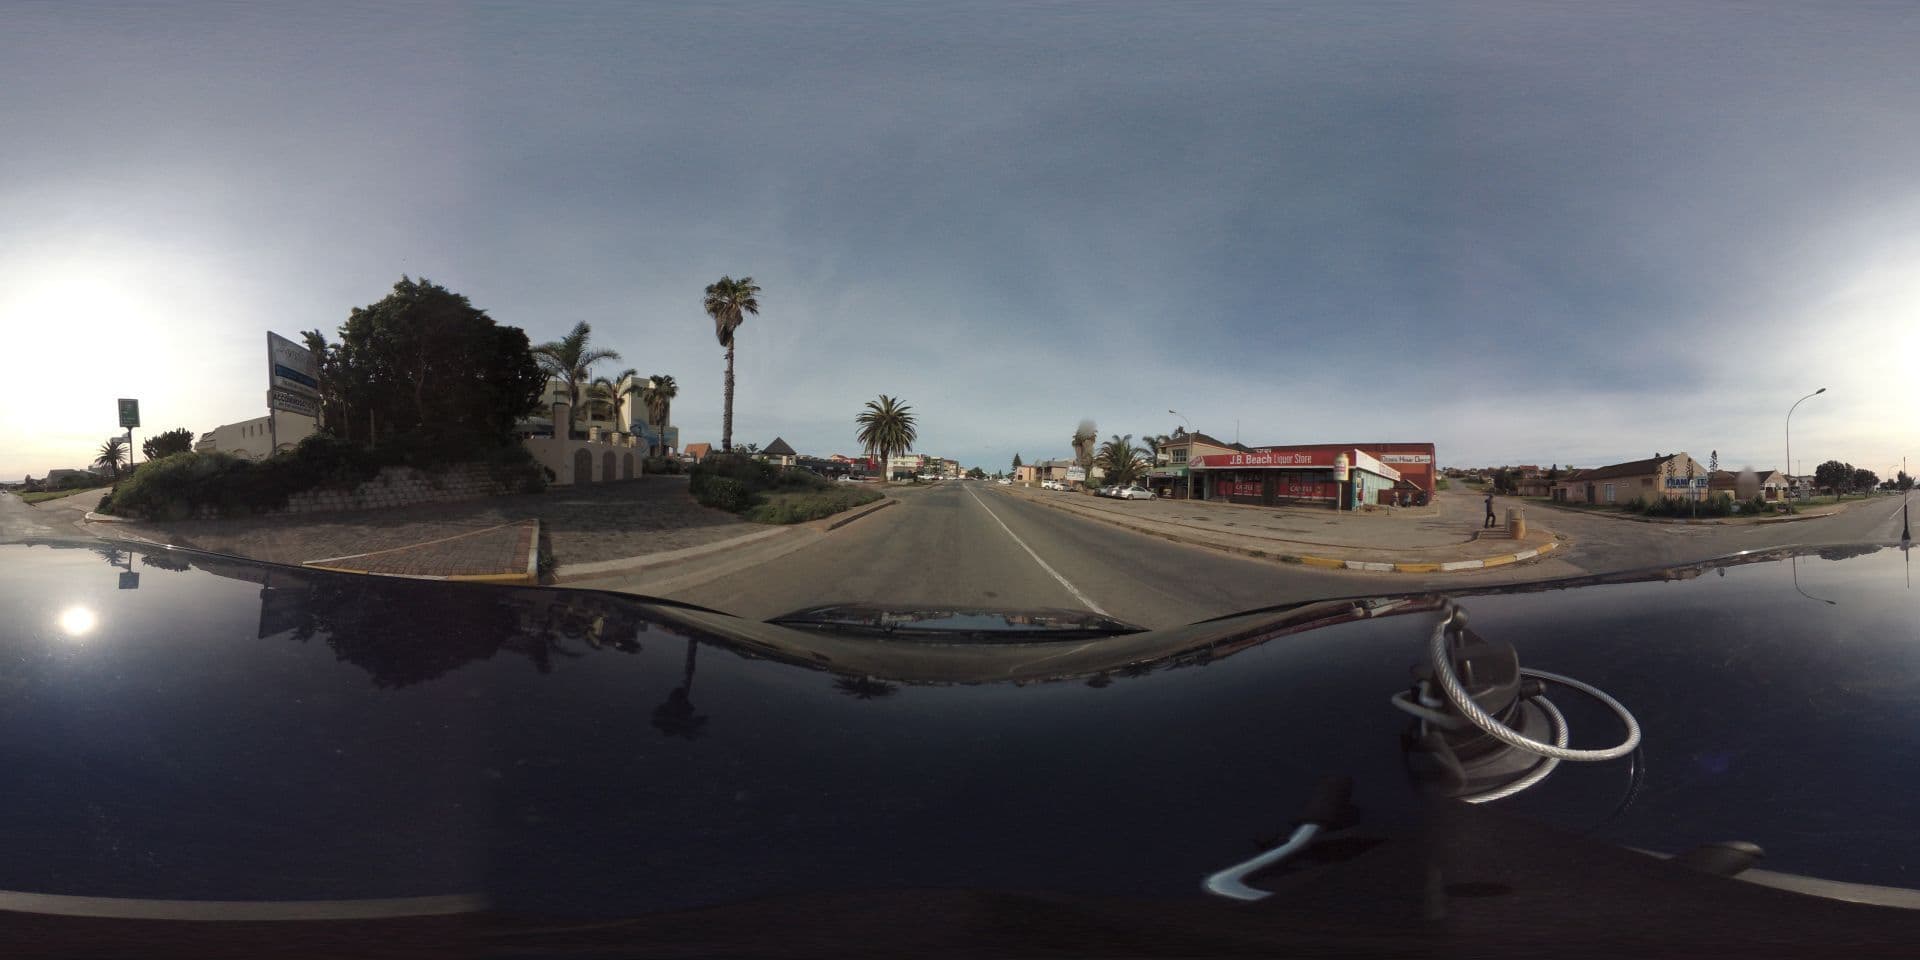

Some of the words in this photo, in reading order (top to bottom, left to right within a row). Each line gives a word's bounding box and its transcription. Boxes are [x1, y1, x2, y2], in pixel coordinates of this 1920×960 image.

[1230, 455, 1244, 464] J.B.
[1246, 454, 1272, 464] Beach
[1273, 454, 1293, 466] Liquor
[1294, 454, 1312, 464] Store
